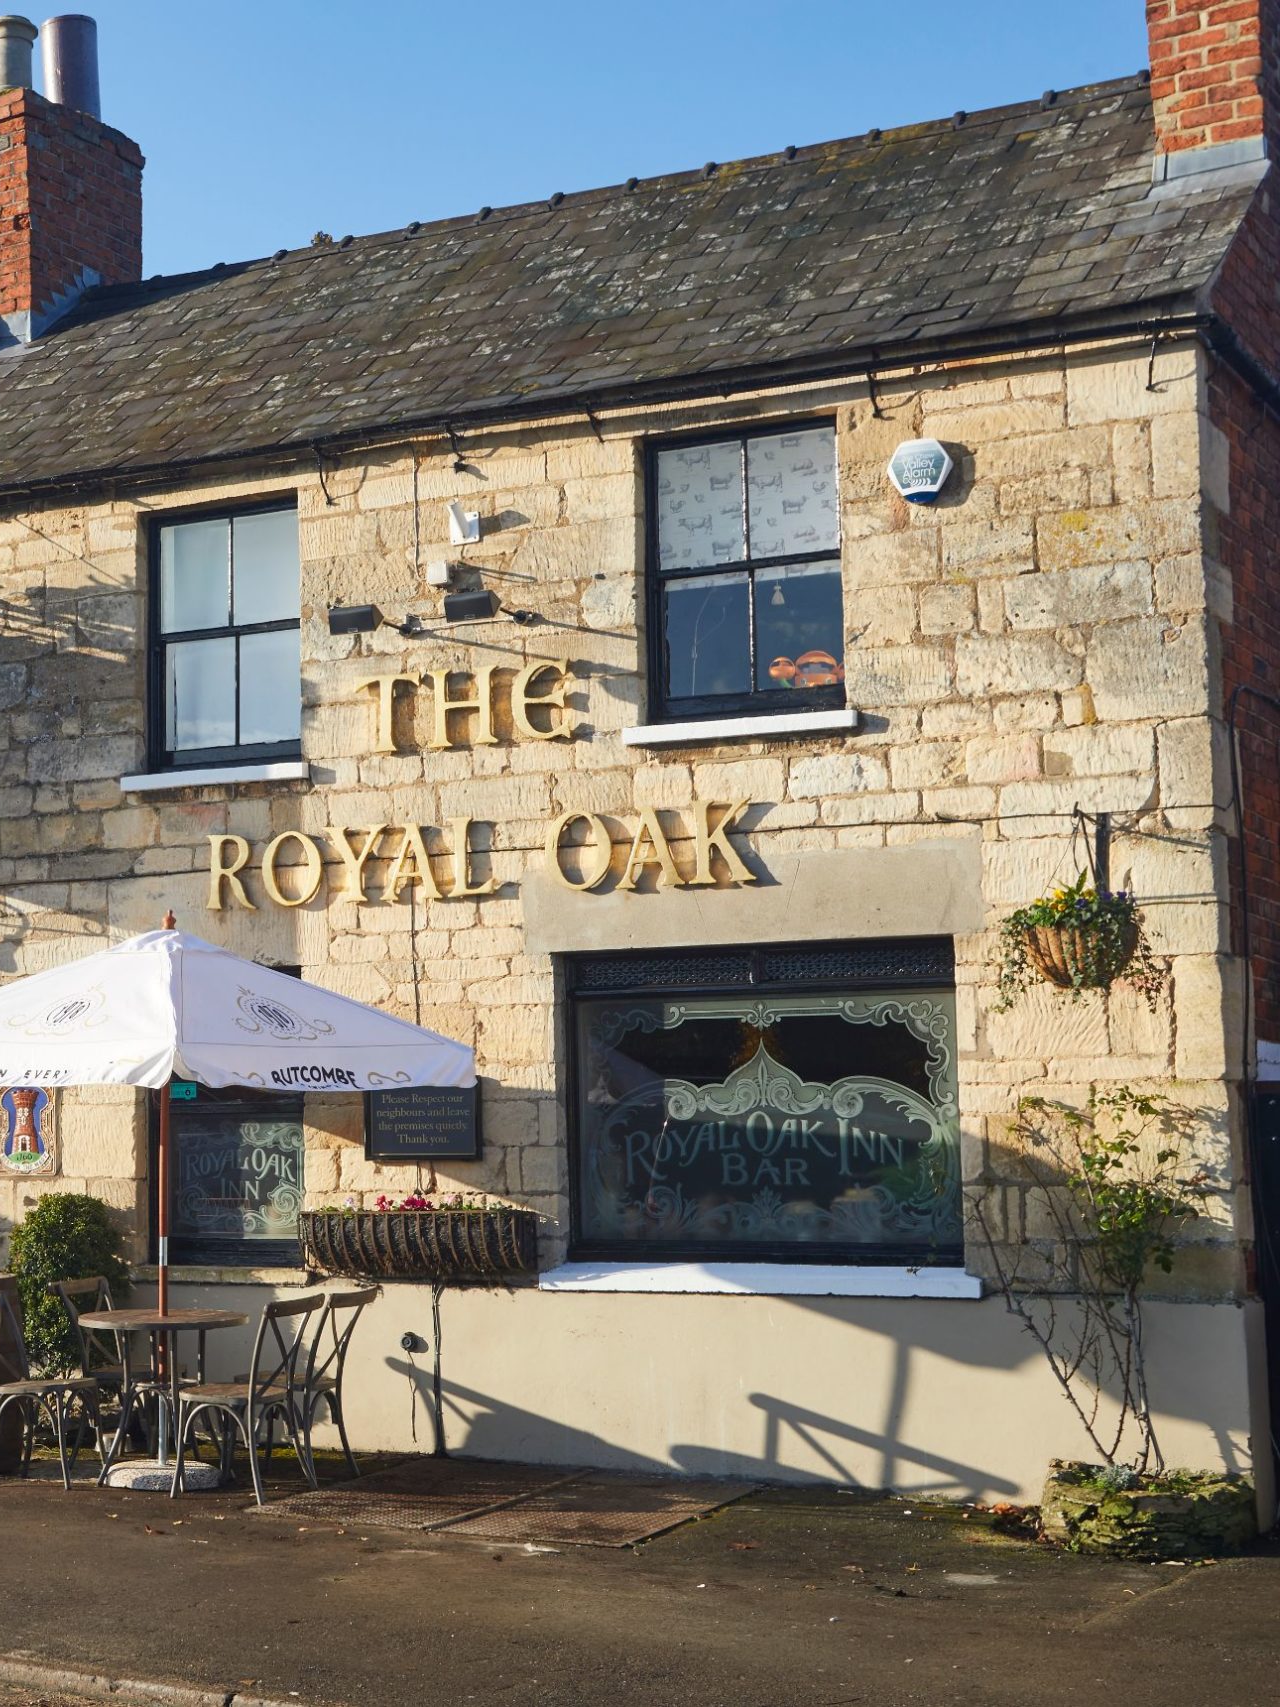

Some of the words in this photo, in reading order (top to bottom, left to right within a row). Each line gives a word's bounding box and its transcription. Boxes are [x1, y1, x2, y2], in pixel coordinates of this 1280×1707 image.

[355, 658, 572, 753] THE
[206, 817, 501, 911] ROYAL
[547, 796, 758, 892] OAK
[376, 1107, 426, 1119] neighbours
[427, 1107, 445, 1117] and
[447, 1106, 470, 1116] leave
[381, 1094, 410, 1104] Please
[412, 1093, 446, 1106] Respect
[447, 1095, 464, 1103] our
[378, 1121, 393, 1131] the
[394, 1121, 434, 1133] premises
[396, 1134, 428, 1144] Thank
[745, 1110, 836, 1168] OAK
[837, 1116, 904, 1177] INN
[186, 1149, 249, 1181] ROYAL
[251, 1148, 297, 1182] OAK
[721, 1152, 811, 1187] BAR
[221, 1177, 260, 1201] INN
